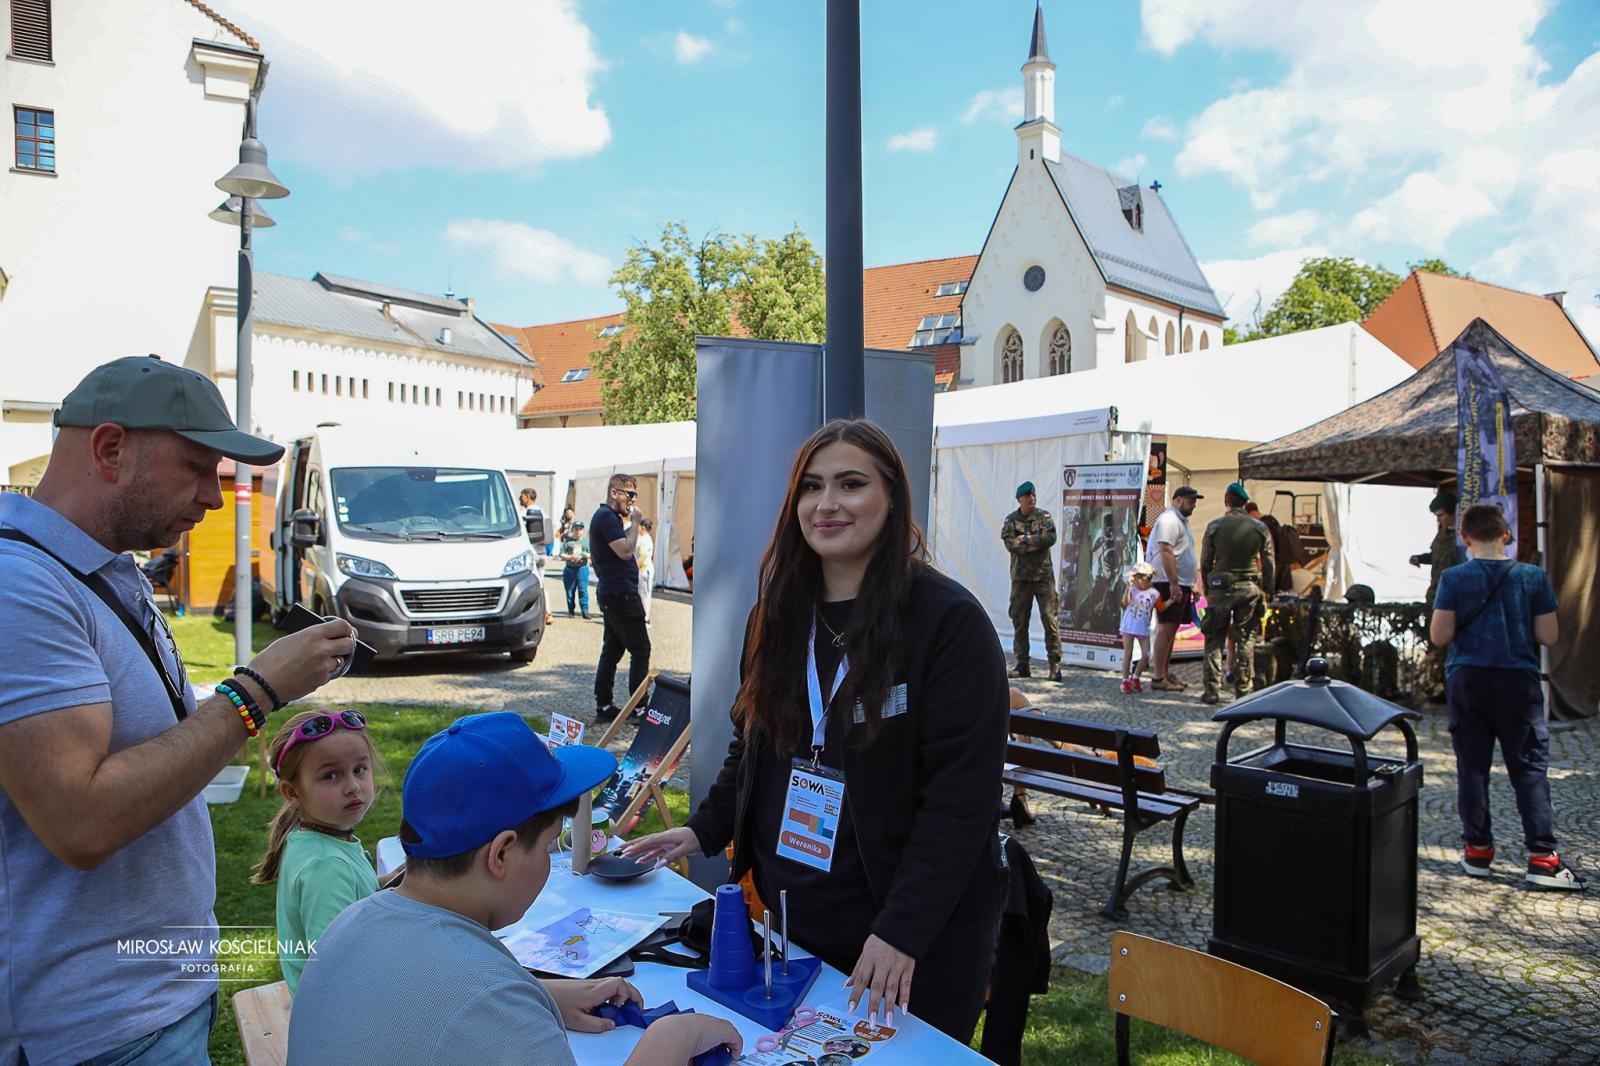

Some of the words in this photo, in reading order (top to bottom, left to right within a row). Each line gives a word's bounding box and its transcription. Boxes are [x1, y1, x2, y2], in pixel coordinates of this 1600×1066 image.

[435, 630, 454, 640] SRB
[457, 628, 483, 640] PE94
[792, 776, 824, 795] SOWA
[789, 836, 822, 854] Weronika
[817, 1011, 841, 1024] SOWA
